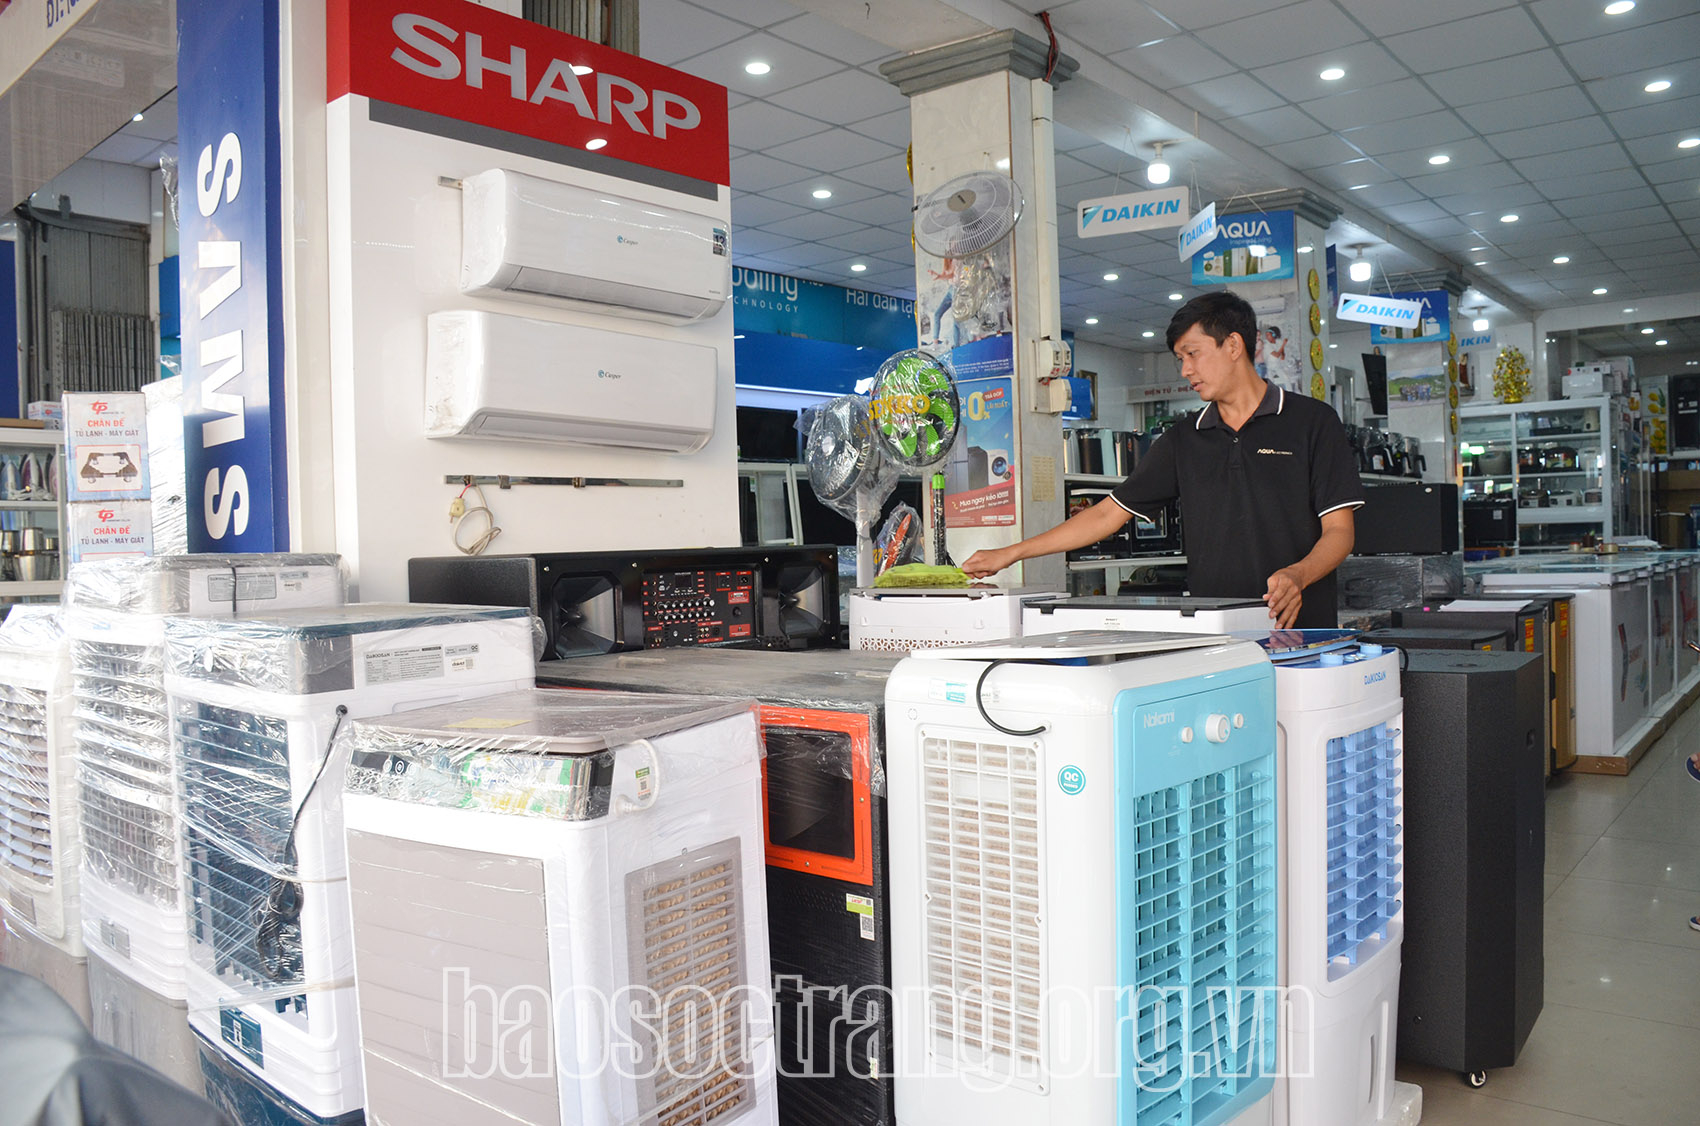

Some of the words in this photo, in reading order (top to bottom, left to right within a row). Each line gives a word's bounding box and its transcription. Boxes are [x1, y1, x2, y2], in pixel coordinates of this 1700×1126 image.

[390, 13, 701, 140] SHARP
[1101, 199, 1181, 224] DAIKIN
[1186, 215, 1213, 247] DAIKIN
[1217, 220, 1272, 239] AQUA
[1356, 303, 1415, 320] DAIKIN
[1459, 334, 1491, 348] IKIN
[1064, 771, 1079, 782] QC
